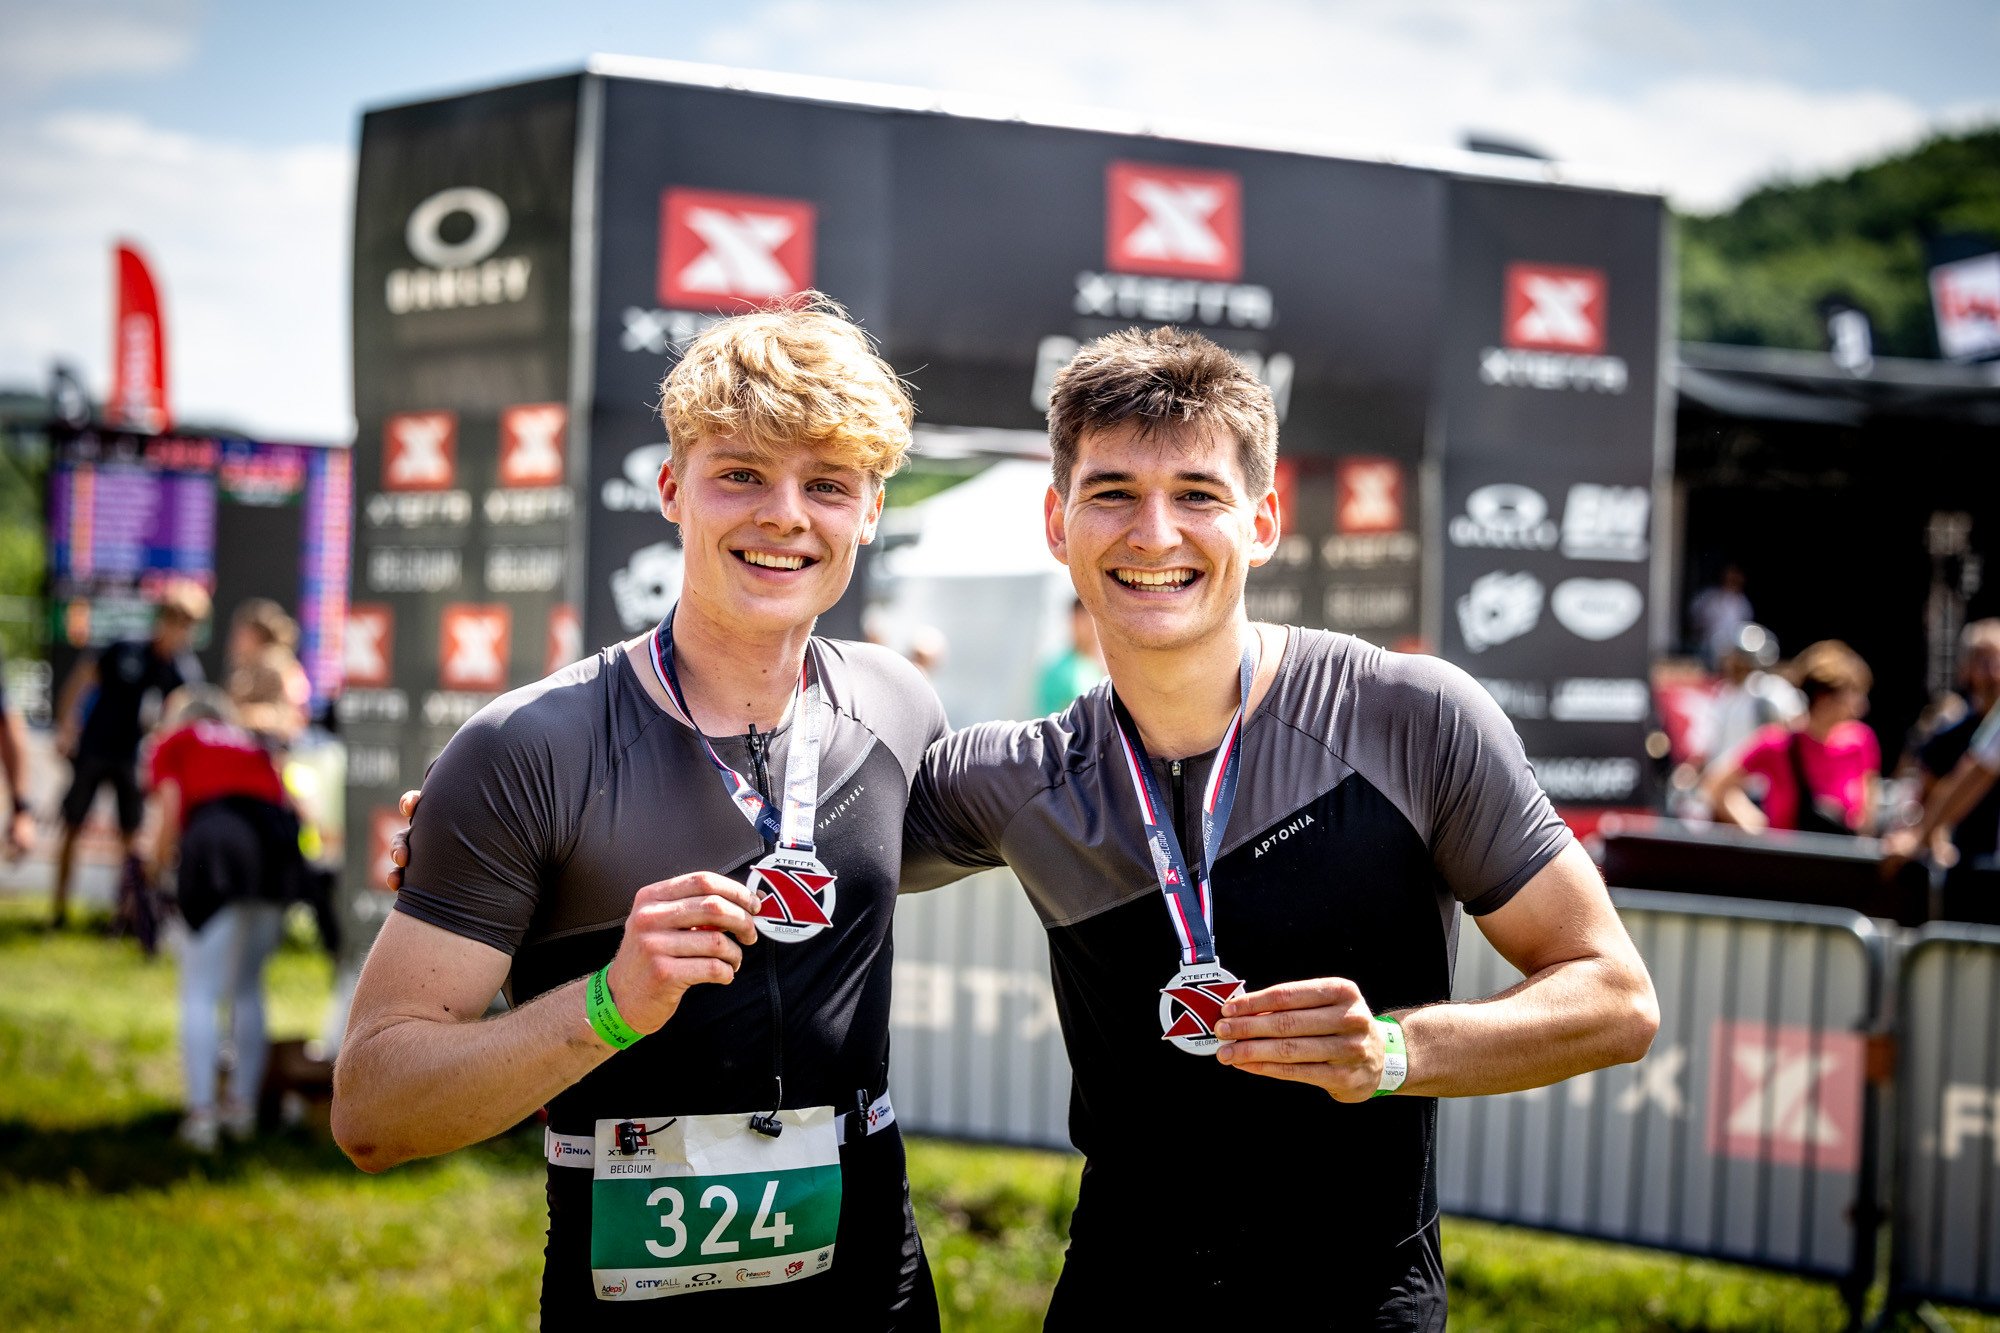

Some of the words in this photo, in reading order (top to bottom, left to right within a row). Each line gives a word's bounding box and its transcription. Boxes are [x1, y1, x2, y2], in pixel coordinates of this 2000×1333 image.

[1254, 814, 1315, 858] APTONIA
[775, 858, 816, 867] XTERRA
[1181, 972, 1221, 981] XTERRA
[610, 1165, 652, 1174] BELGIUM
[645, 1180, 794, 1258] 324
[685, 1280, 722, 1288] OAKLEY
[601, 1285, 622, 1293] Adeps
